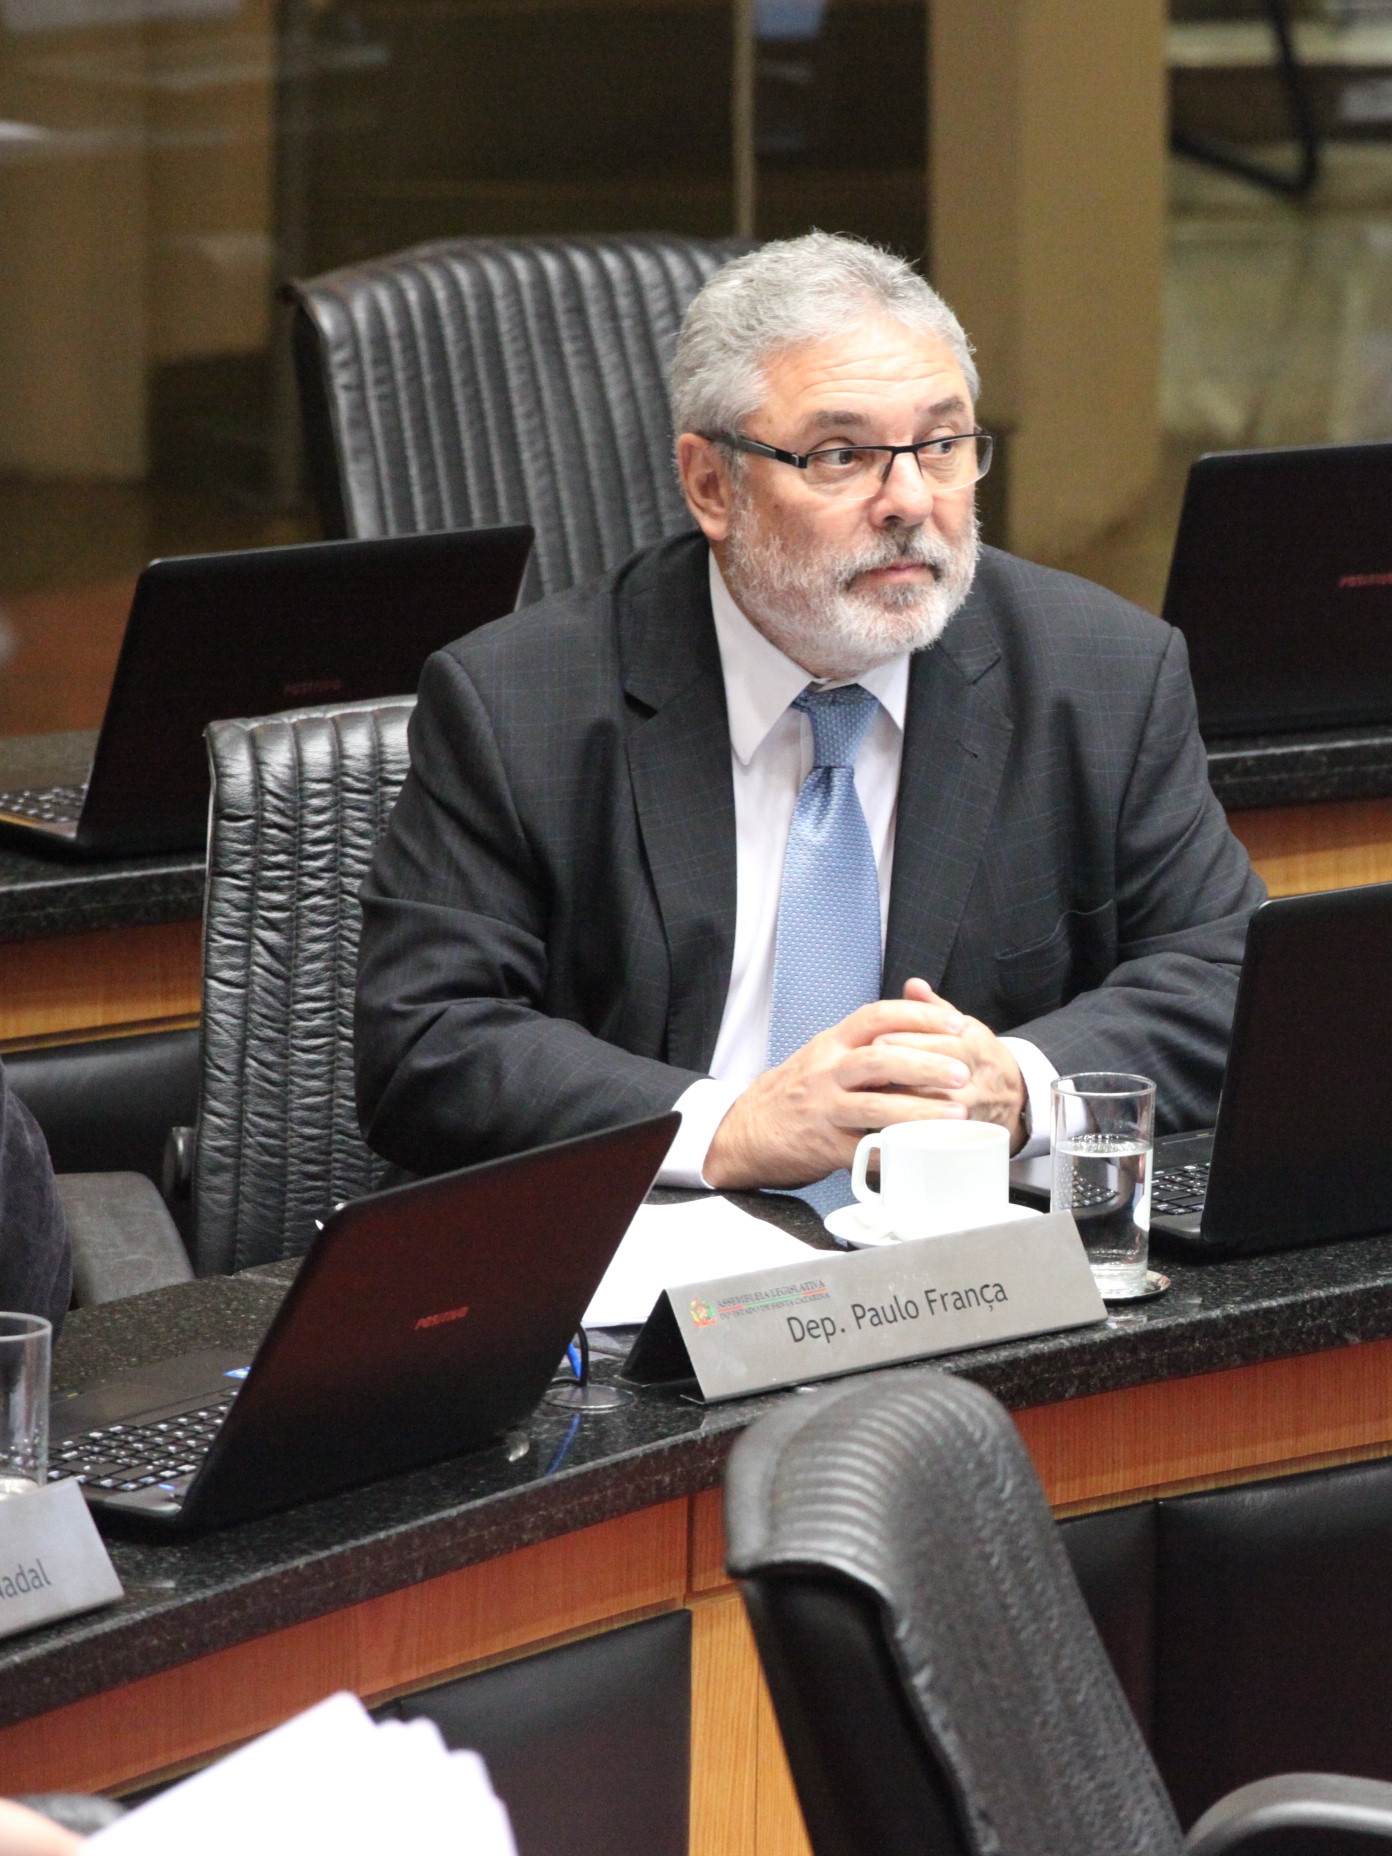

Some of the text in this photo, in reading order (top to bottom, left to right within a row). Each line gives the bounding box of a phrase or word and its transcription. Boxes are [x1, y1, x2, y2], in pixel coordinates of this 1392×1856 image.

[786, 1283, 1009, 1344] Dep. Paulo França
[0, 1559, 52, 1598] adal
